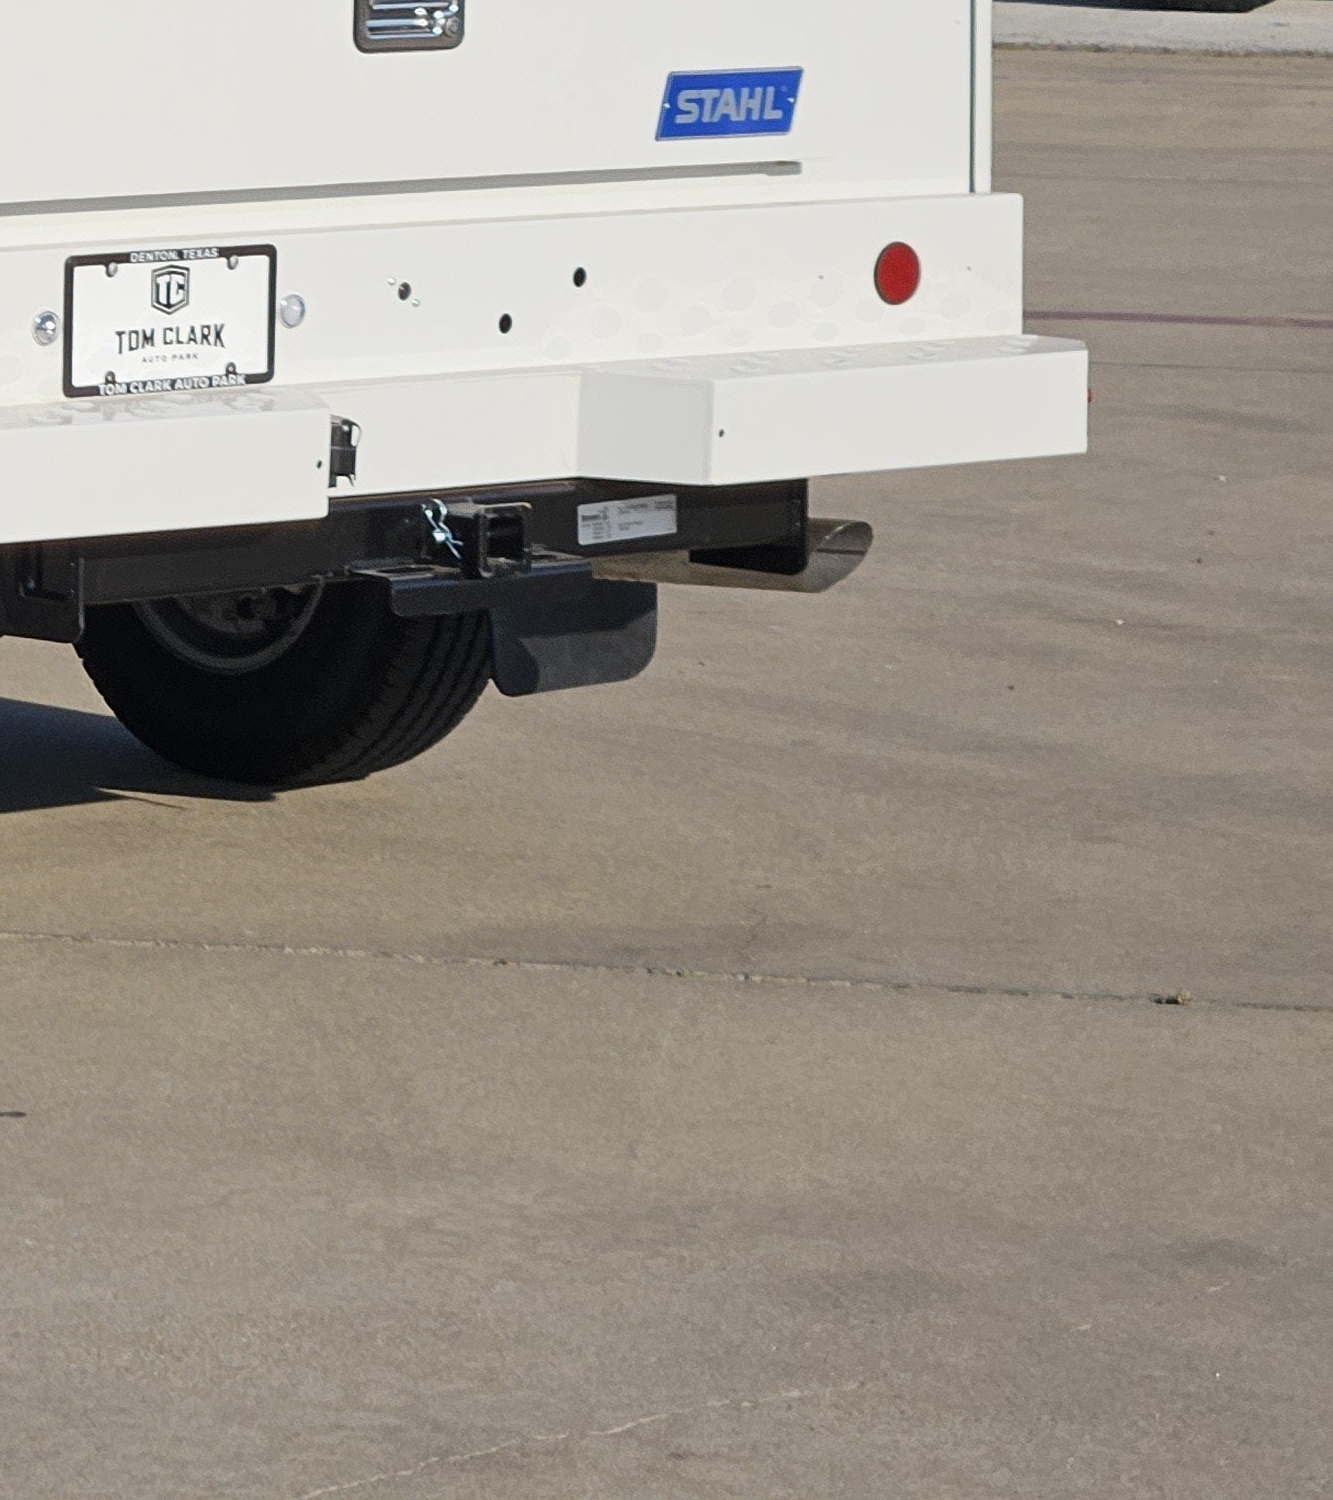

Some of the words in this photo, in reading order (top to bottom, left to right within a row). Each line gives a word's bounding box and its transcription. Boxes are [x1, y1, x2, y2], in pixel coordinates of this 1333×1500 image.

[674, 86, 784, 124] STAHL
[181, 247, 220, 260] TEXAS
[115, 328, 155, 354] TOM
[163, 323, 226, 349] CLARK
[141, 354, 168, 363] AUTO
[171, 353, 199, 361] PARK
[98, 383, 127, 396] TOM
[130, 380, 172, 394] CLARK
[175, 377, 210, 390] AUTO
[212, 375, 246, 388] PARK
